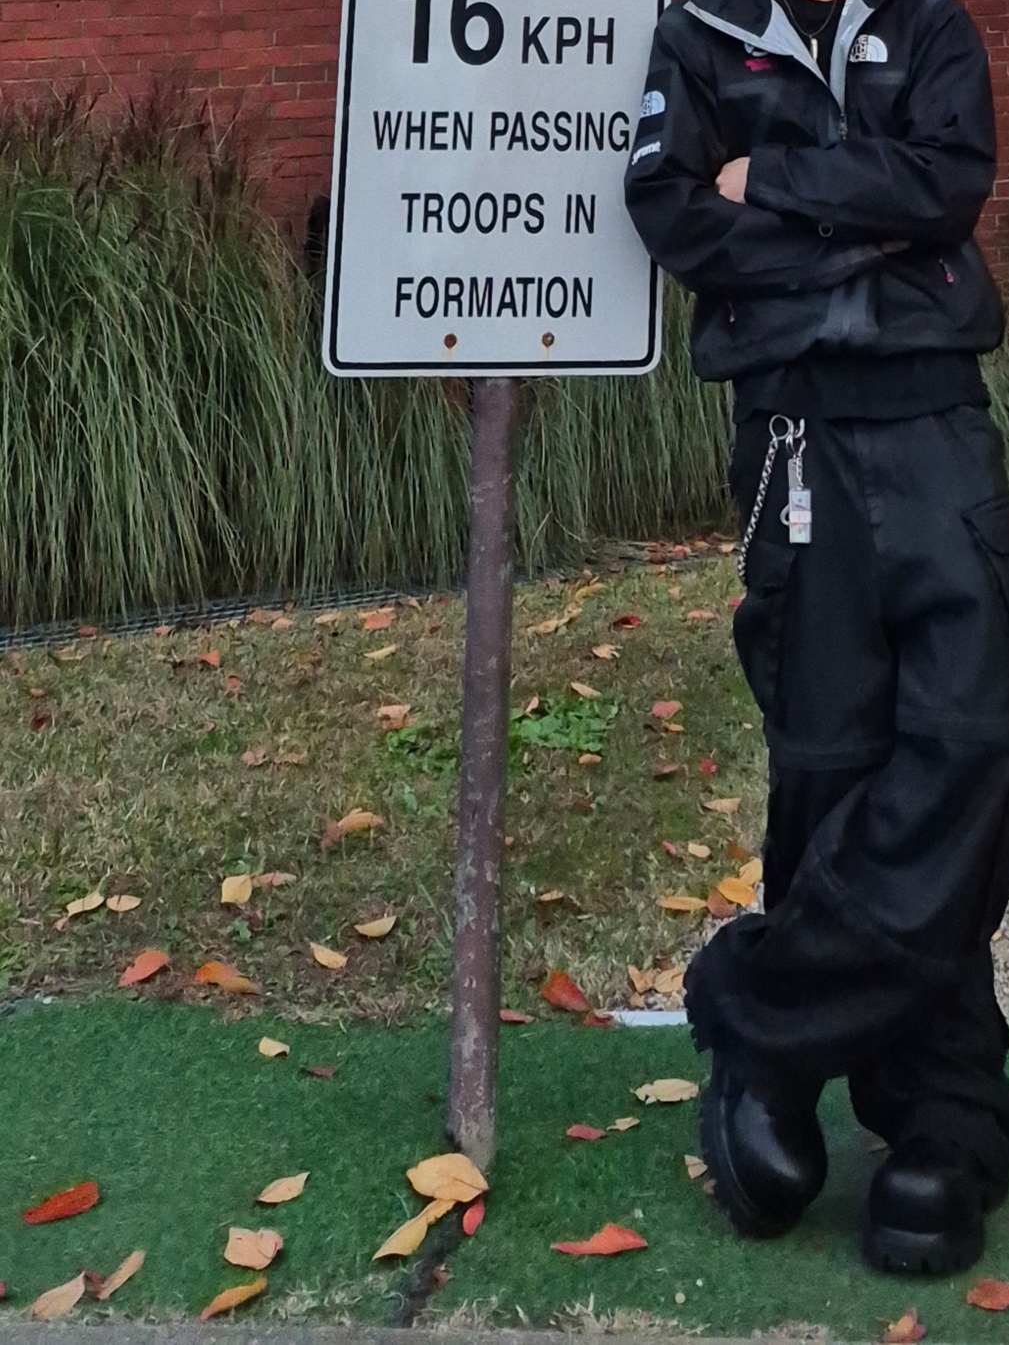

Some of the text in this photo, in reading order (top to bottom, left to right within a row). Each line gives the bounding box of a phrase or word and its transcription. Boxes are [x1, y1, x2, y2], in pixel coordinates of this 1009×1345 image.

[521, 16, 615, 65] KPH
[372, 110, 474, 151] WHEN
[489, 110, 631, 153] PASSING
[400, 191, 597, 235] TROOPS IN
[395, 275, 594, 319] FORMATION
